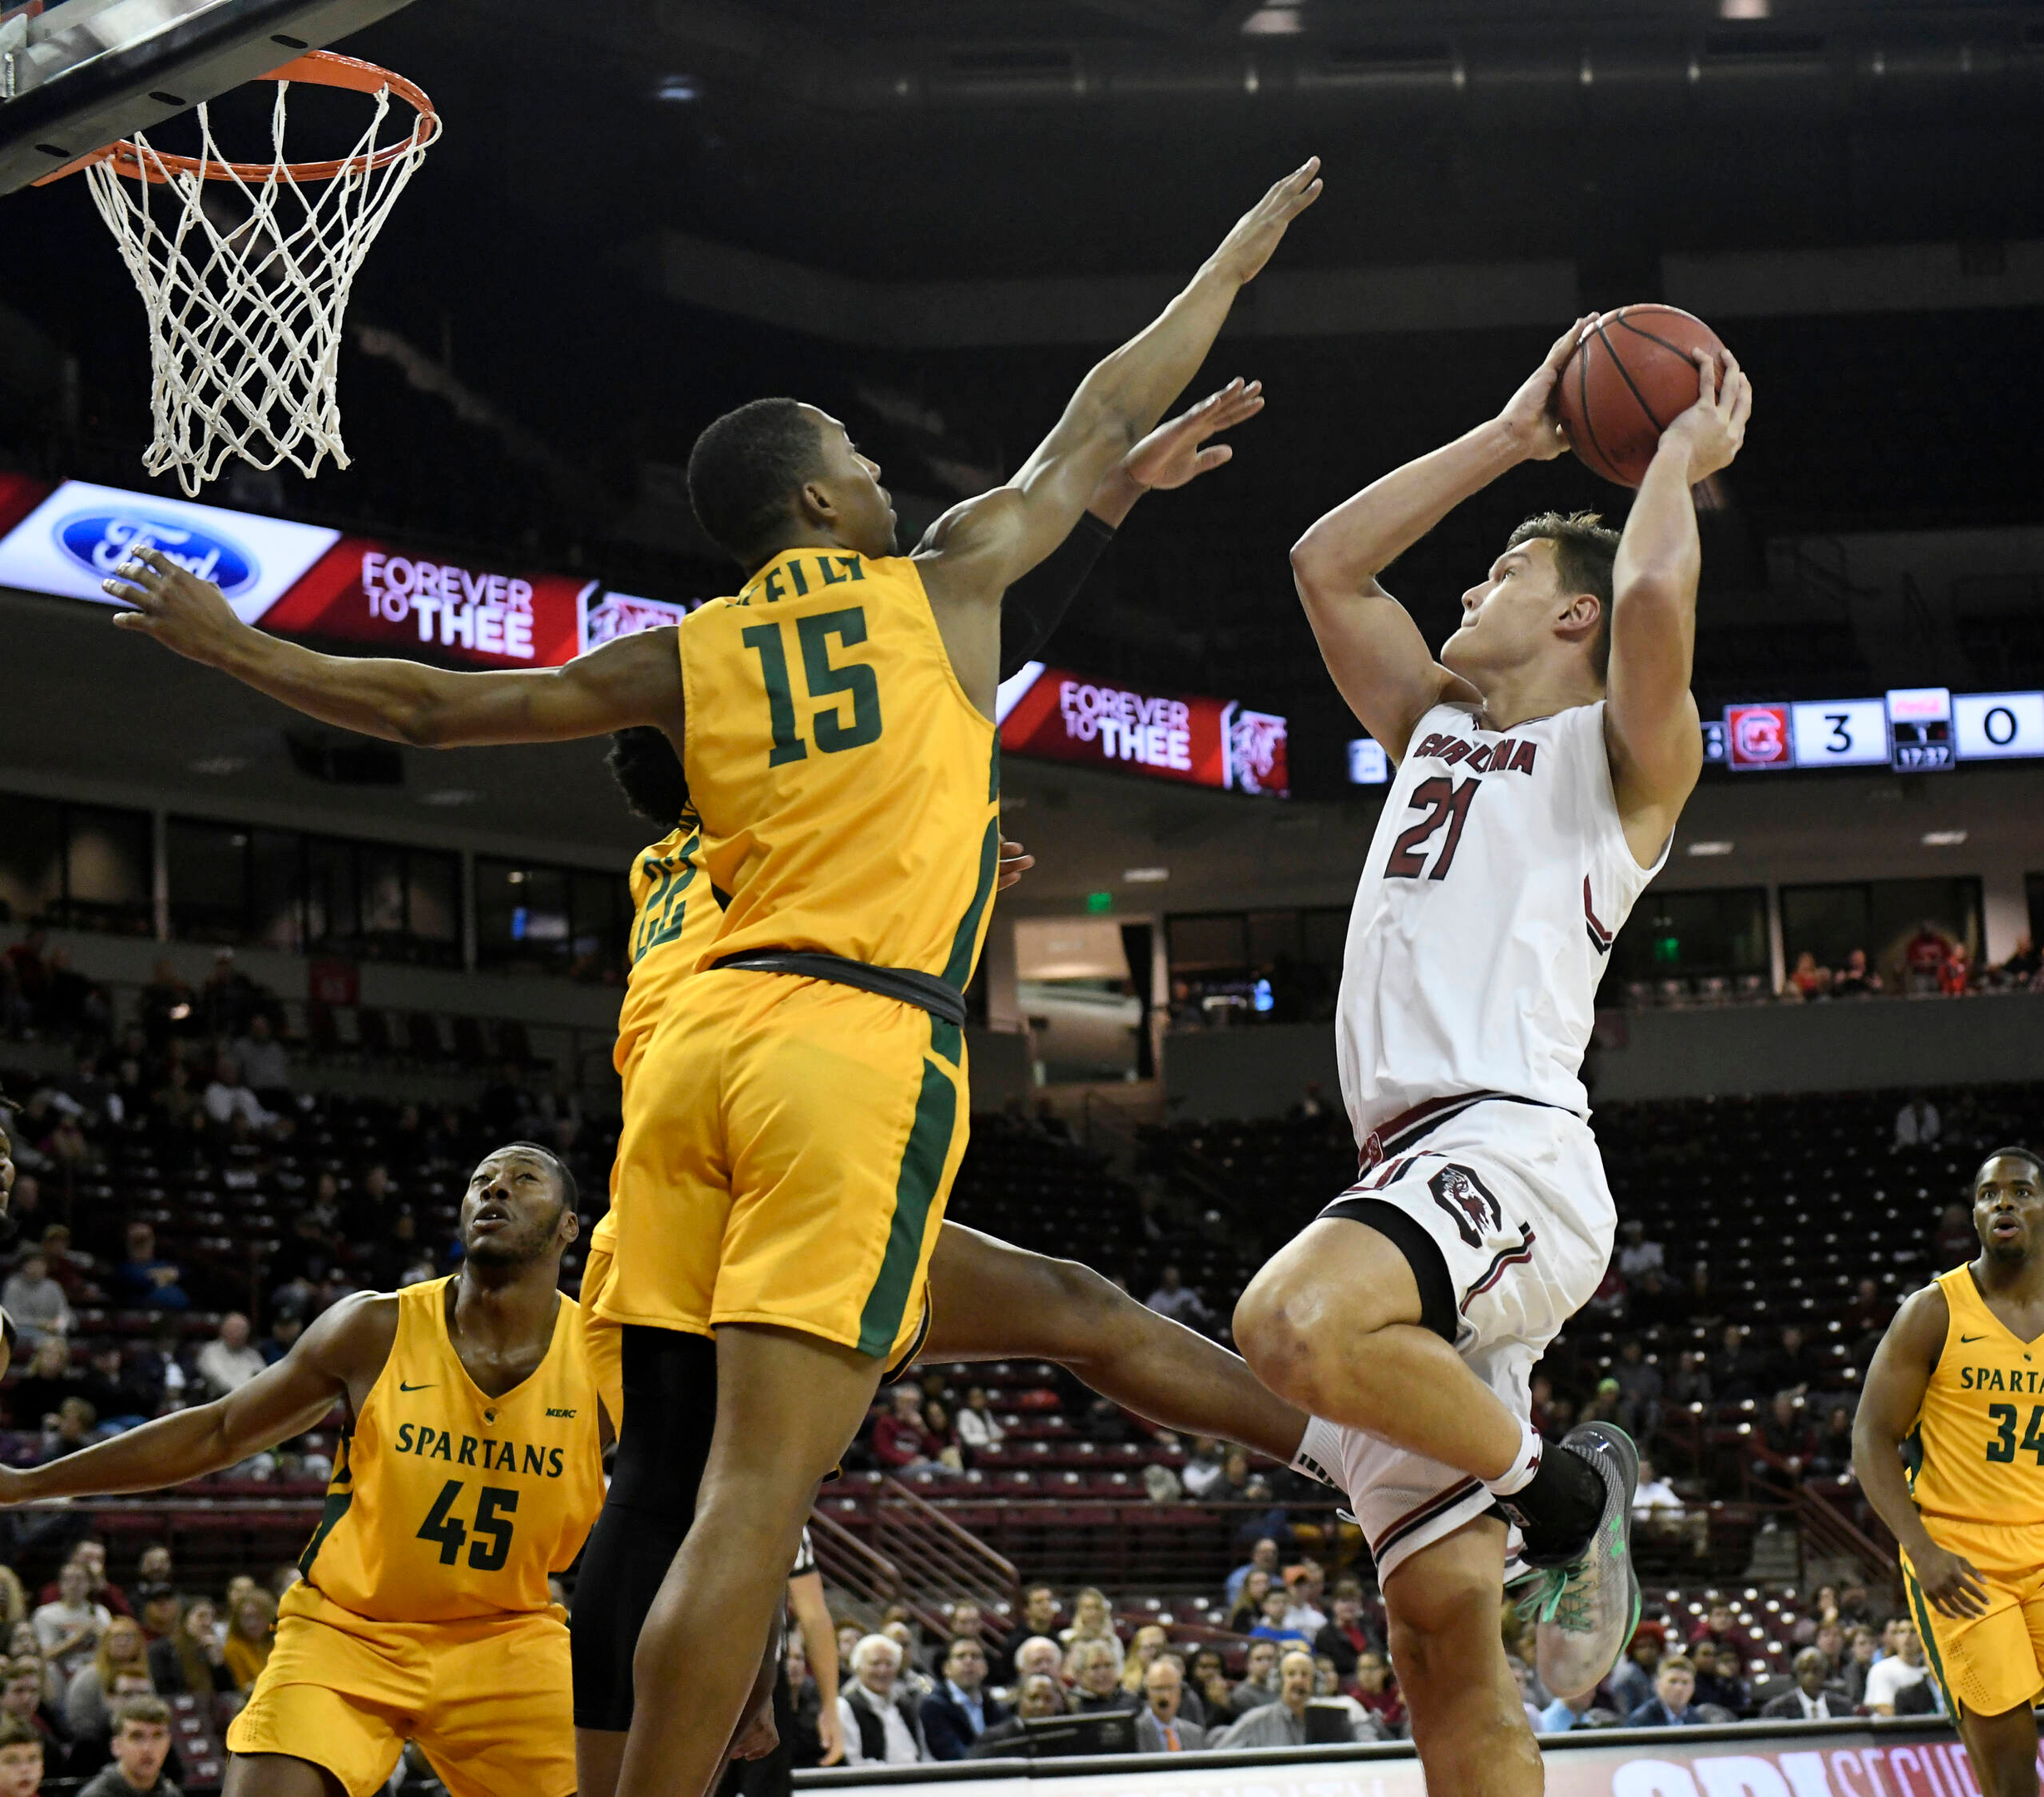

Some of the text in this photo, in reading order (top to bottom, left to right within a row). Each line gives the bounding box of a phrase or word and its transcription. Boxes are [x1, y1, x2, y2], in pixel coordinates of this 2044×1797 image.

[363, 552, 533, 613] FOREVER
[364, 586, 535, 659] TO THEE
[741, 606, 883, 768] 15
[1060, 681, 1190, 731] FOREVER
[1062, 711, 1192, 771] TO THEE
[1824, 715, 1852, 753] 3
[1984, 708, 2017, 745] 0
[1383, 776, 1482, 881] 21
[634, 834, 701, 965] 22
[545, 1408, 577, 1418] MEAC
[1987, 1403, 2044, 1466] 34
[395, 1423, 564, 1478] SPARTANS
[416, 1479, 519, 1572] 45
